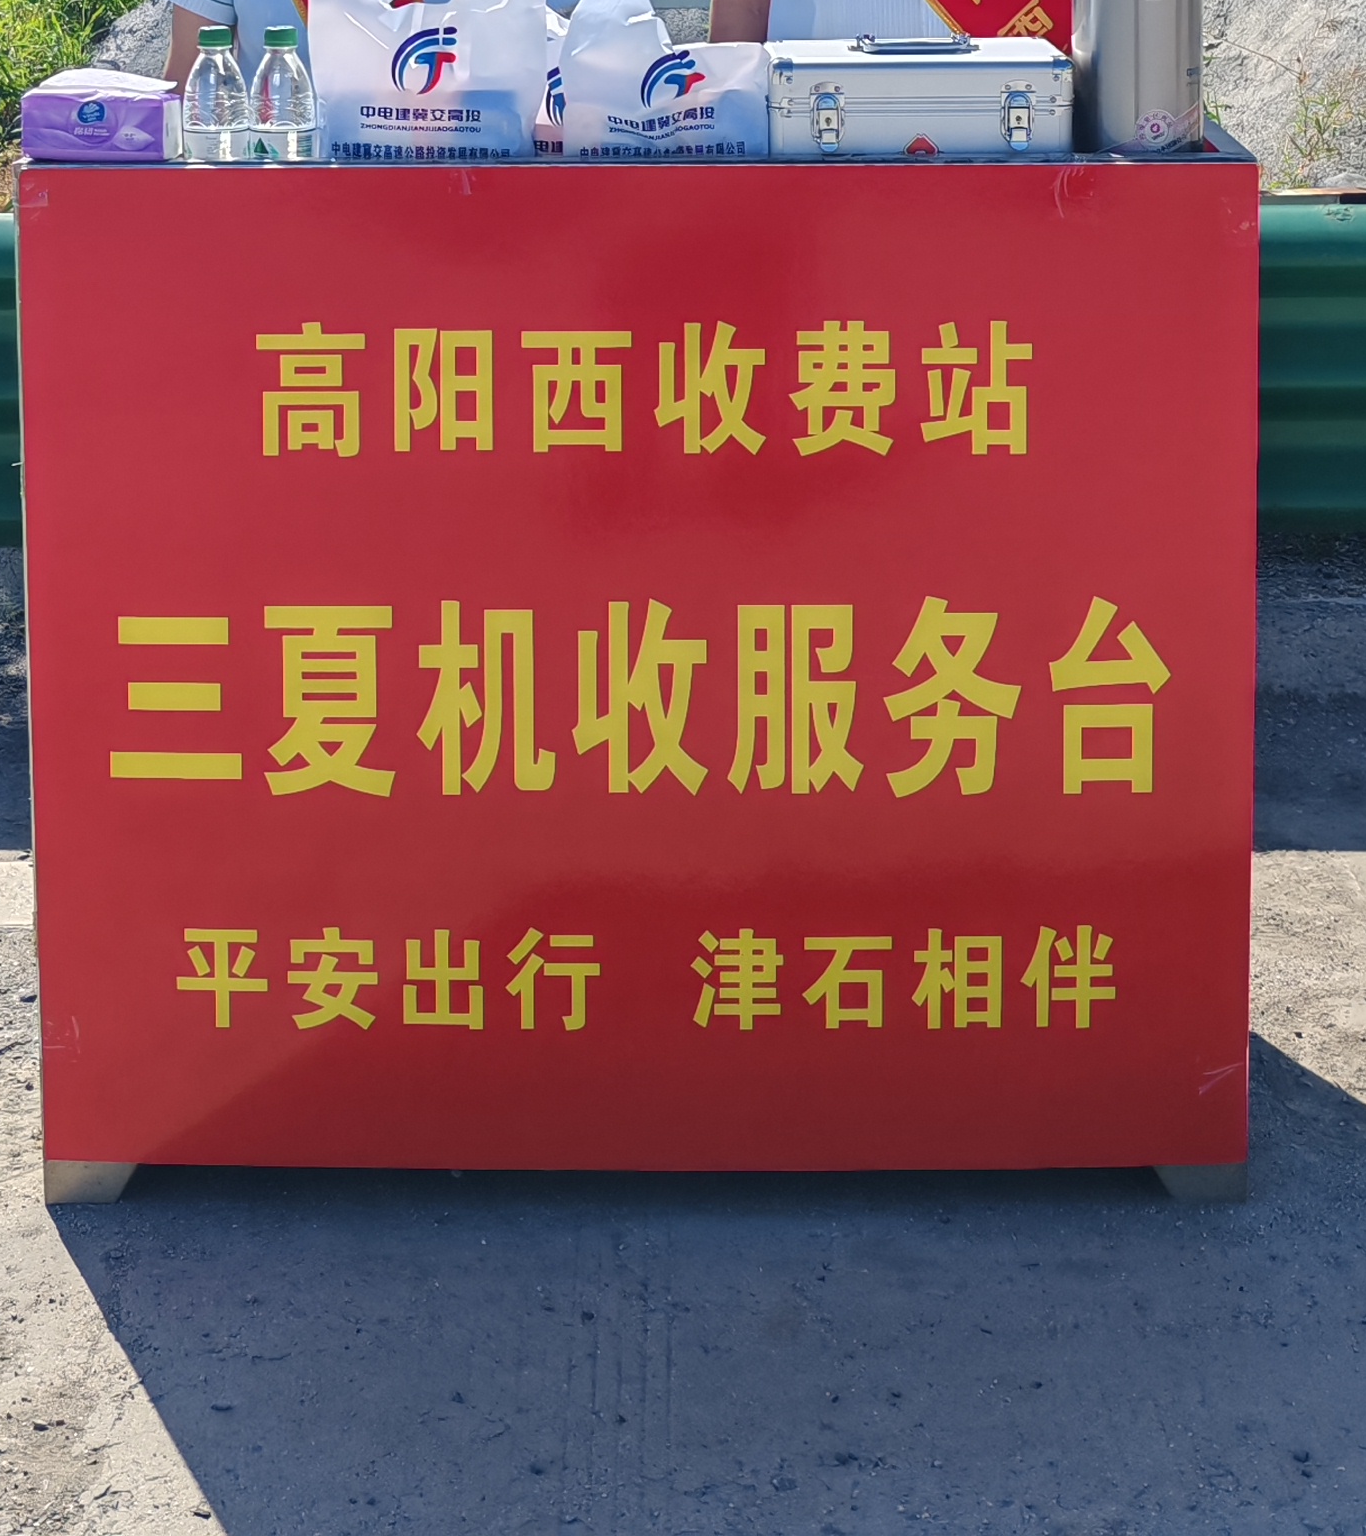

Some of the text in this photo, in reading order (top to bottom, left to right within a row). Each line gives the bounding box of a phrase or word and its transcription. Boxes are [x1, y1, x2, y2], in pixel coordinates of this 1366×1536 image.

[360, 106, 482, 123] 中电建冀交高投
[255, 320, 1034, 458] 高阳西收费站
[109, 596, 1172, 799] 三夏机收服务台
[176, 926, 1117, 1031] 平安出行 津石相伴
